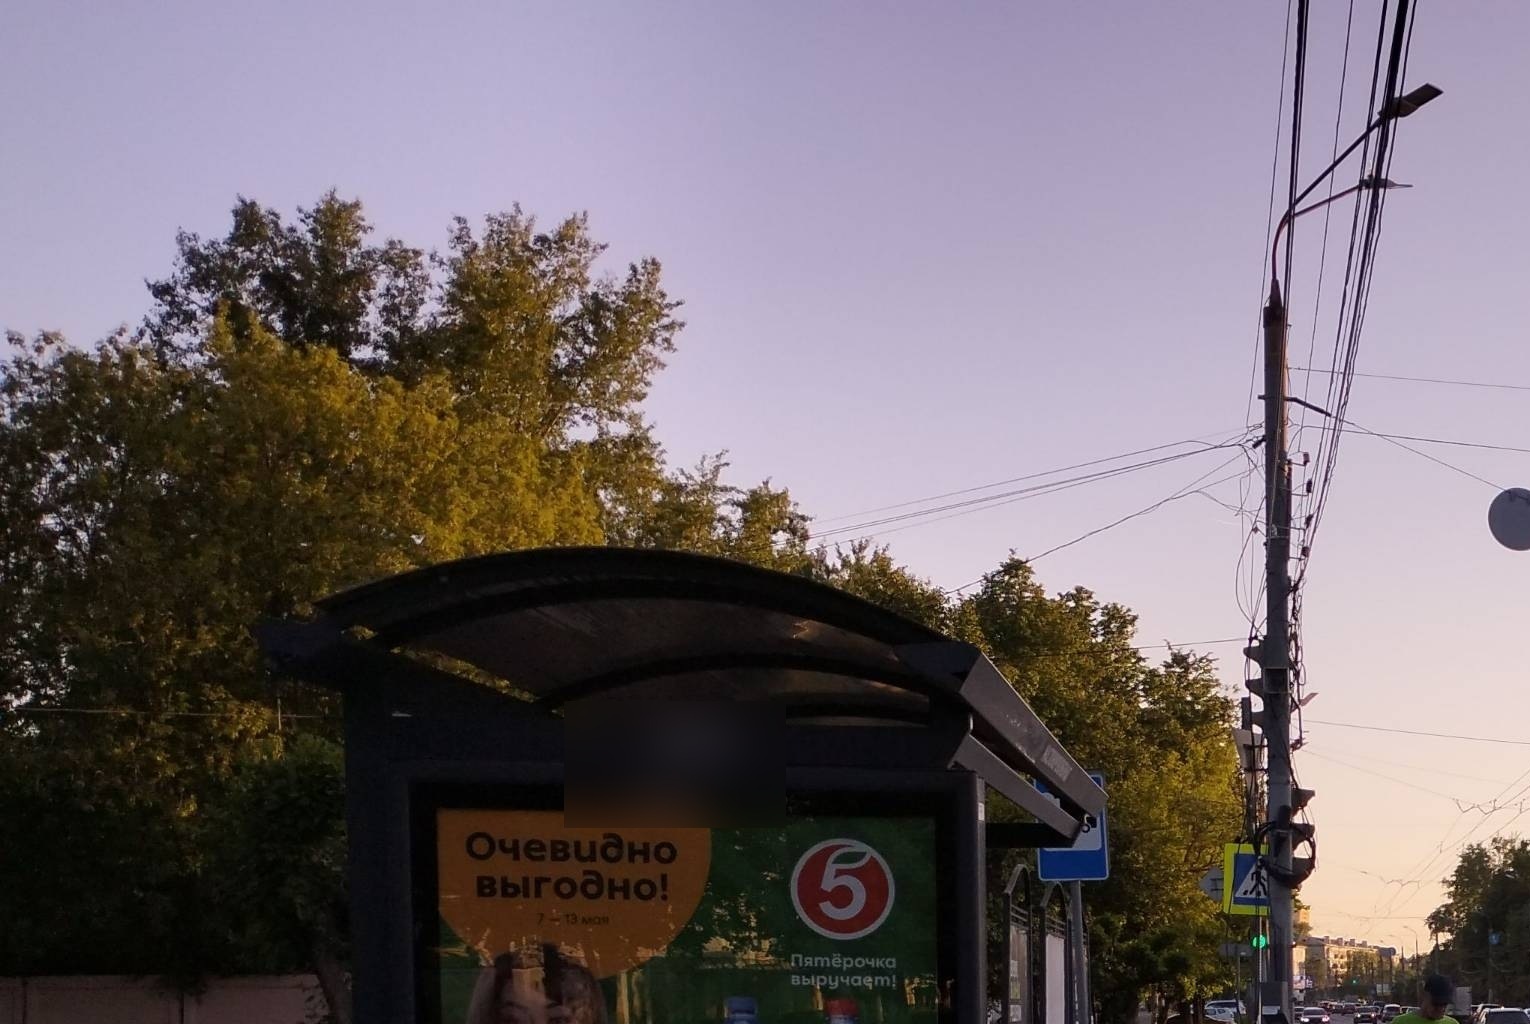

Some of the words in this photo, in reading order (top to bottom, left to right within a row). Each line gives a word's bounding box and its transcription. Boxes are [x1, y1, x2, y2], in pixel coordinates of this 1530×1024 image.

[465, 831, 678, 865] Очевидно
[476, 868, 669, 901] выгодно!
[536, 912, 545, 926] 7
[565, 913, 579, 925] 13
[581, 915, 610, 926] мая
[790, 953, 897, 972] Пятёрочка
[790, 973, 897, 990] выручает!
